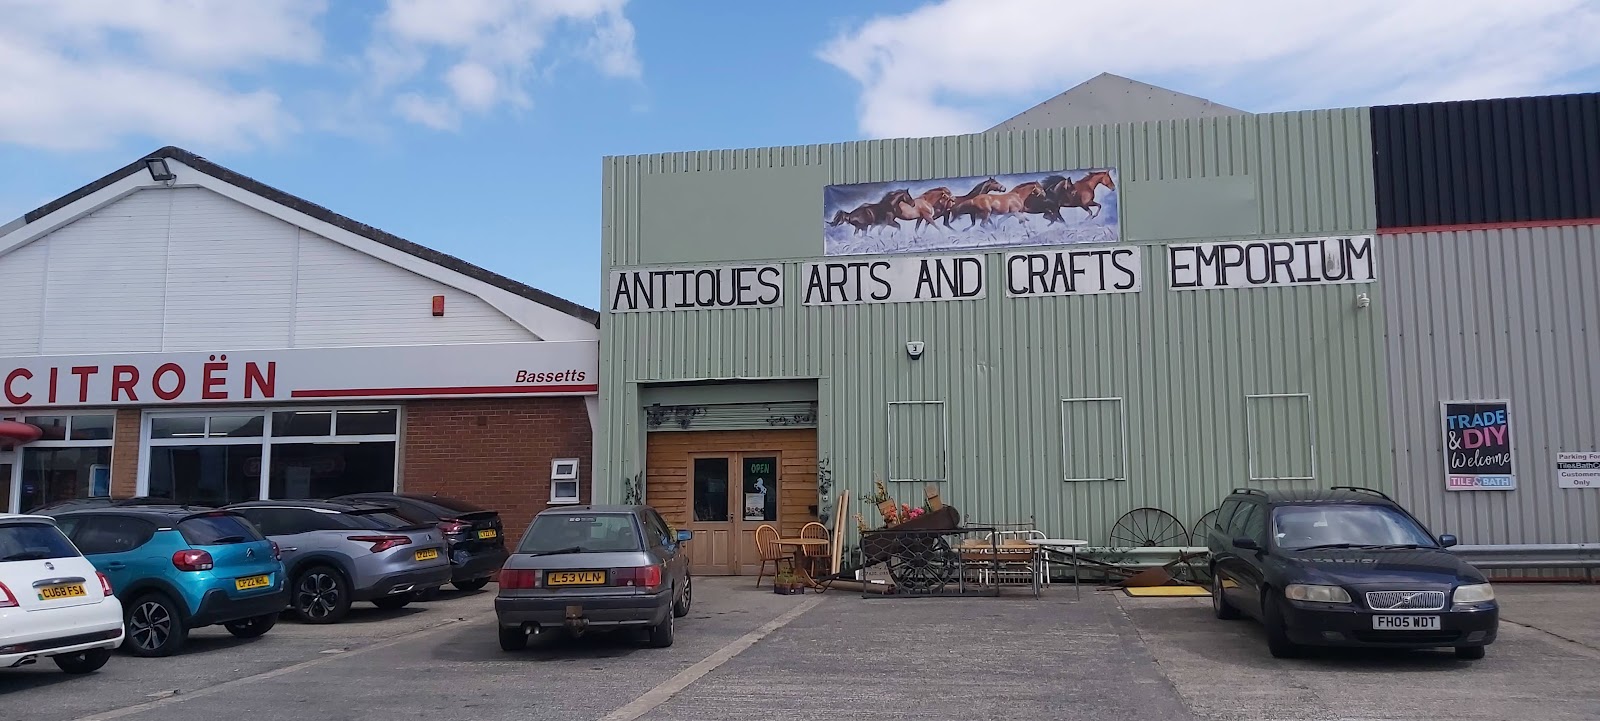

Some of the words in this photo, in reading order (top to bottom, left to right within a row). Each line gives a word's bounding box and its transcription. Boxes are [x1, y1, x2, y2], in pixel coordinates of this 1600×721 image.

[612, 267, 781, 310] ANTIQUES
[803, 262, 892, 303] ARTS
[914, 257, 983, 299] AND
[1007, 249, 1135, 294] CRAFTS
[1170, 238, 1374, 288] EMPORIUM
[4, 354, 276, 405] CITROËN
[515, 369, 586, 383] Bassetts
[1447, 410, 1506, 429] TRADE
[1448, 430, 1462, 450] &
[1463, 425, 1507, 449] DIY
[1451, 449, 1511, 469] Welcome
[1558, 453, 1587, 461] Parking
[751, 463, 769, 474] OPEN
[1573, 479, 1591, 487] Only
[554, 573, 576, 583] L53
[578, 572, 600, 582] VLN
[42, 586, 66, 598] CU68
[68, 585, 85, 596] FSA
[1378, 616, 1410, 628] FH05
[1413, 616, 1436, 628] WDT
